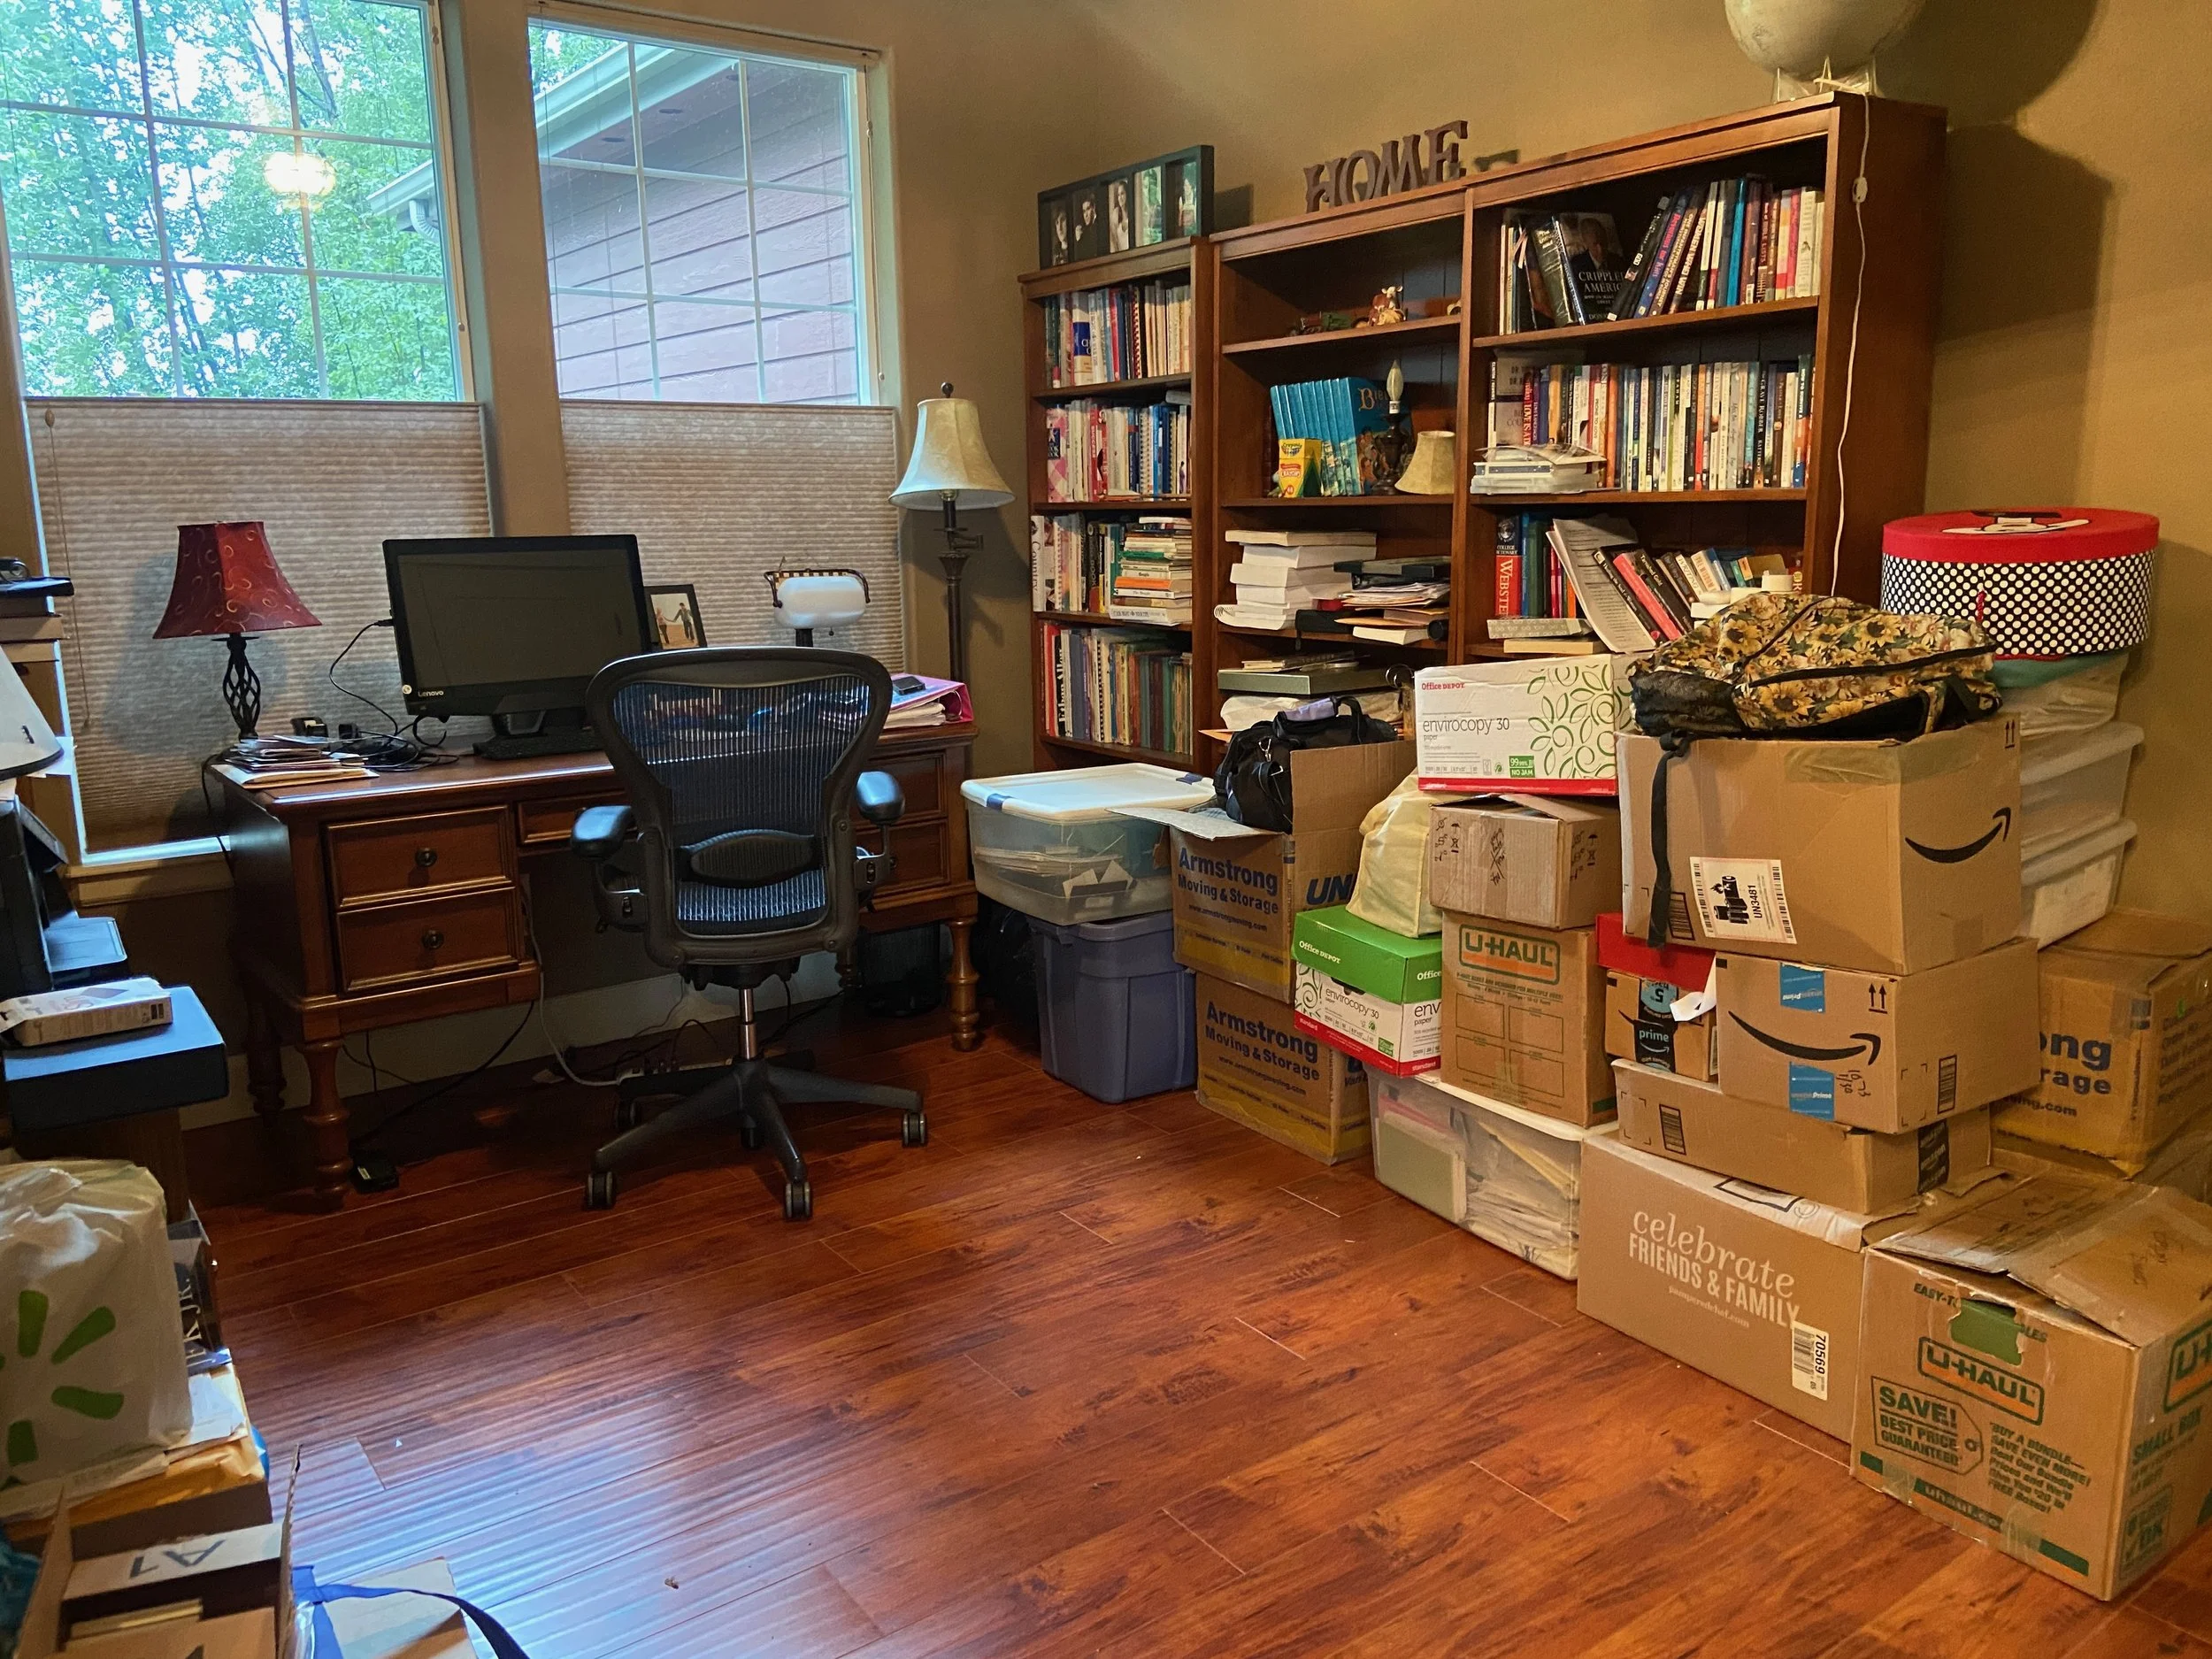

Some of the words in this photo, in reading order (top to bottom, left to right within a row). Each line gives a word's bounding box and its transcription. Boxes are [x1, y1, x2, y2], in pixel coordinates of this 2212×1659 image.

[1303, 120, 1468, 212] HOME
[1689, 216, 1706, 252] WOMEN
[1584, 283, 1622, 293] AMERIC
[1675, 275, 1686, 296] WIN
[1499, 559, 1513, 616] WEBSTE
[1640, 554, 1656, 576] Tarnished
[1653, 574, 1663, 587] Gold
[1423, 715, 1493, 735] envirocopy
[1496, 718, 1509, 731] 30
[1179, 848, 1279, 897] Armstrong
[1178, 873, 1217, 902] Moving
[1219, 888, 1228, 902] &
[1230, 888, 1279, 915] Storage
[1747, 885, 1763, 918] UN3481
[1299, 941, 1319, 956] Office
[1319, 950, 1341, 964] DEPOT
[1465, 932, 1554, 967] U-HAUL
[1325, 988, 1371, 1017] envirocopy
[1371, 1009, 1379, 1019] 30
[1414, 1018, 1432, 1026] paper
[1206, 1001, 1318, 1064] Armstrong
[1639, 1029, 1670, 1042] prime
[1205, 1025, 1250, 1058] Moving
[1252, 1048, 1261, 1060] &
[1263, 1048, 1320, 1081] Storage
[2039, 1067, 2111, 1095] rage
[1633, 1210, 1795, 1299] celebrate
[1629, 1232, 1702, 1289] FRIENDS
[1707, 1269, 1720, 1299] &
[1725, 1276, 1800, 1329] FAMILY
[1815, 1334, 1826, 1375] 70569
[1926, 1344, 2035, 1408] U-HAUL
[1879, 1386, 1957, 1430] SAVE!
[1879, 1414, 1914, 1436] BEST
[1917, 1425, 1958, 1451] PRICE
[1881, 1430, 1959, 1467] GUARANTEED
[1925, 1486, 2001, 1528] uhaul.co
